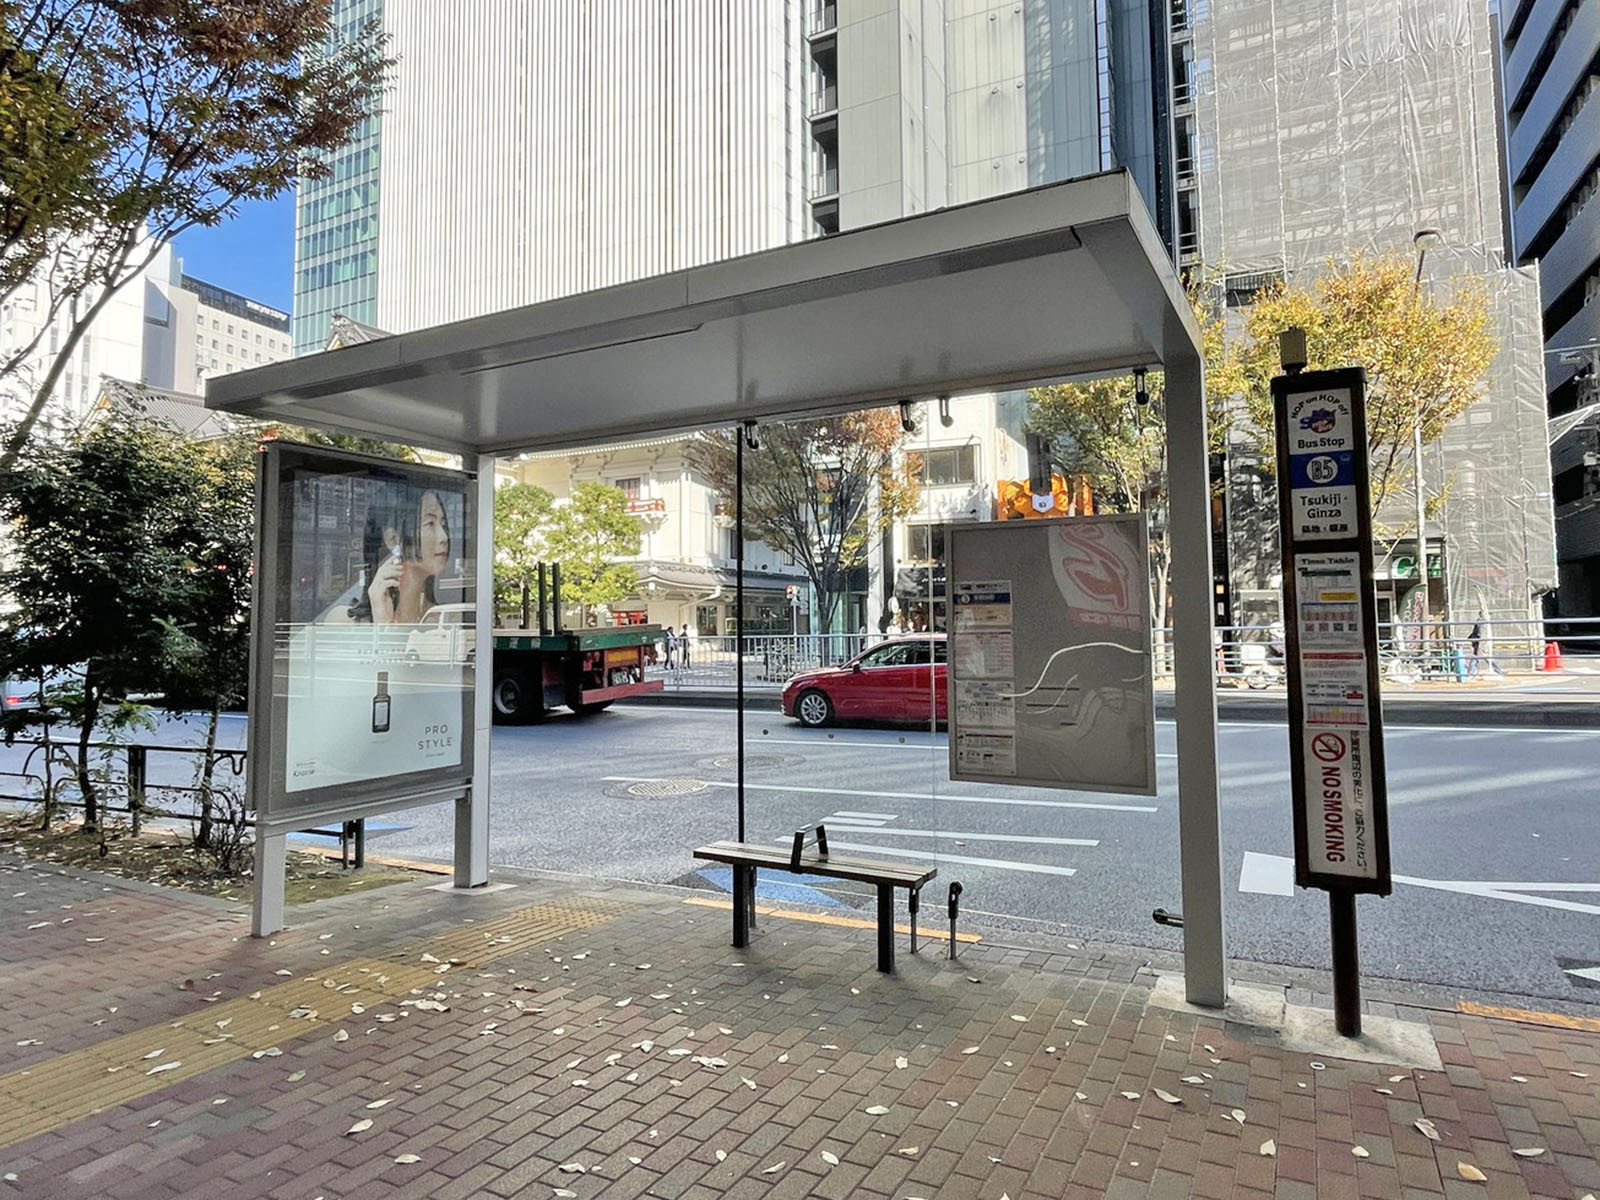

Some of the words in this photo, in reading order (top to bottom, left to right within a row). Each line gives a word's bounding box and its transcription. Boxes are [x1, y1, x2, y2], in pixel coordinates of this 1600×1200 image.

[1291, 401, 1305, 419] HOP
[1319, 394, 1341, 405] HOP
[1298, 439, 1318, 449] Bus
[1320, 437, 1345, 448] Stop
[1311, 460, 1334, 480] B5
[1307, 508, 1341, 518] Ginza
[425, 724, 448, 735] PRO
[417, 737, 453, 750] STYLE
[1323, 789, 1346, 863] SMOKING
